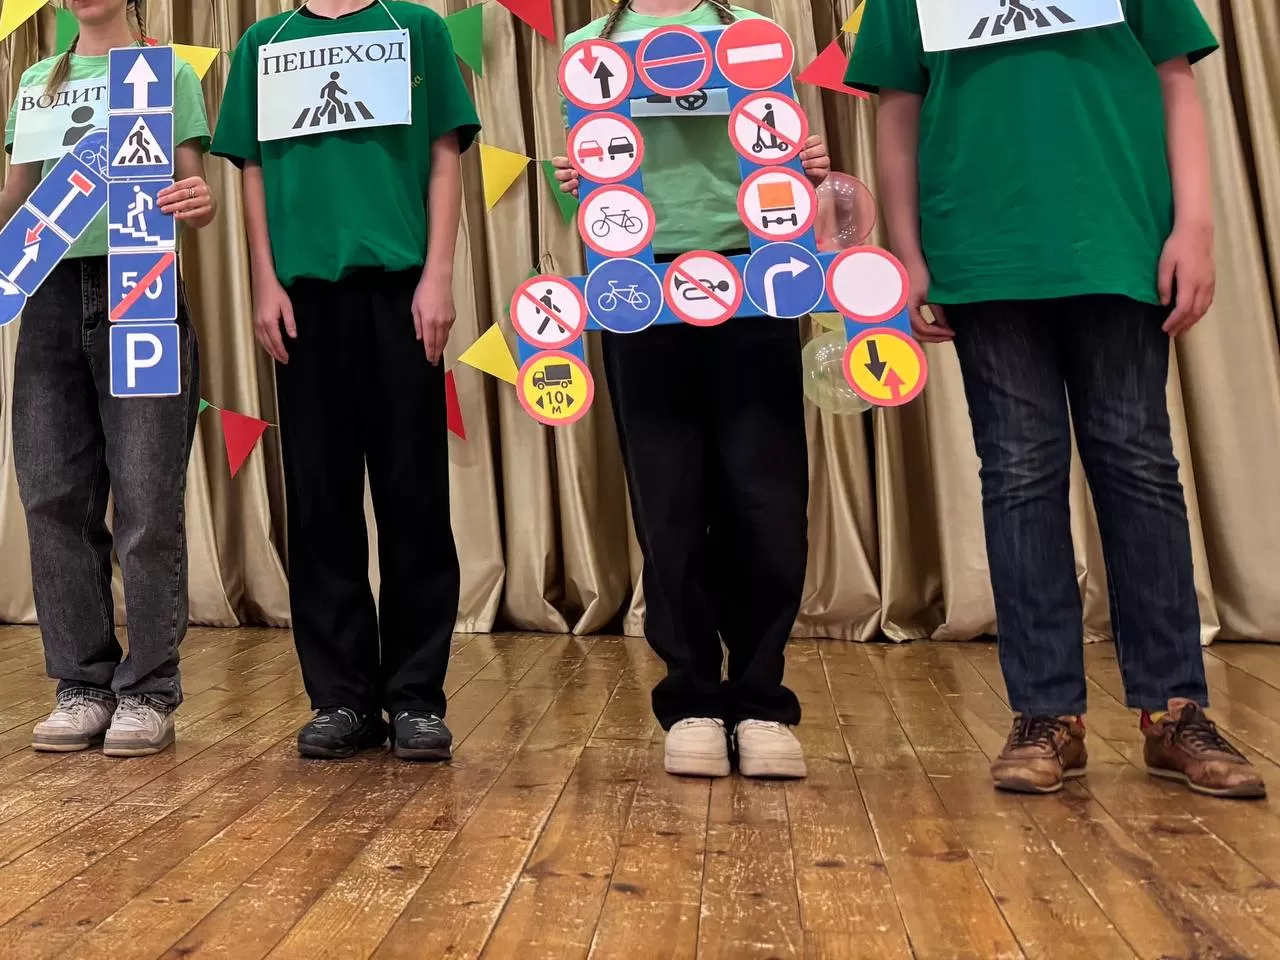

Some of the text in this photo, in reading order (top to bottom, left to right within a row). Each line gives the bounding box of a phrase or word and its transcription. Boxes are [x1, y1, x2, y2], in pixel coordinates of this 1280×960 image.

[262, 41, 407, 76] ПЕШЕХОД
[126, 332, 163, 388] P
[546, 391, 564, 405] 10
